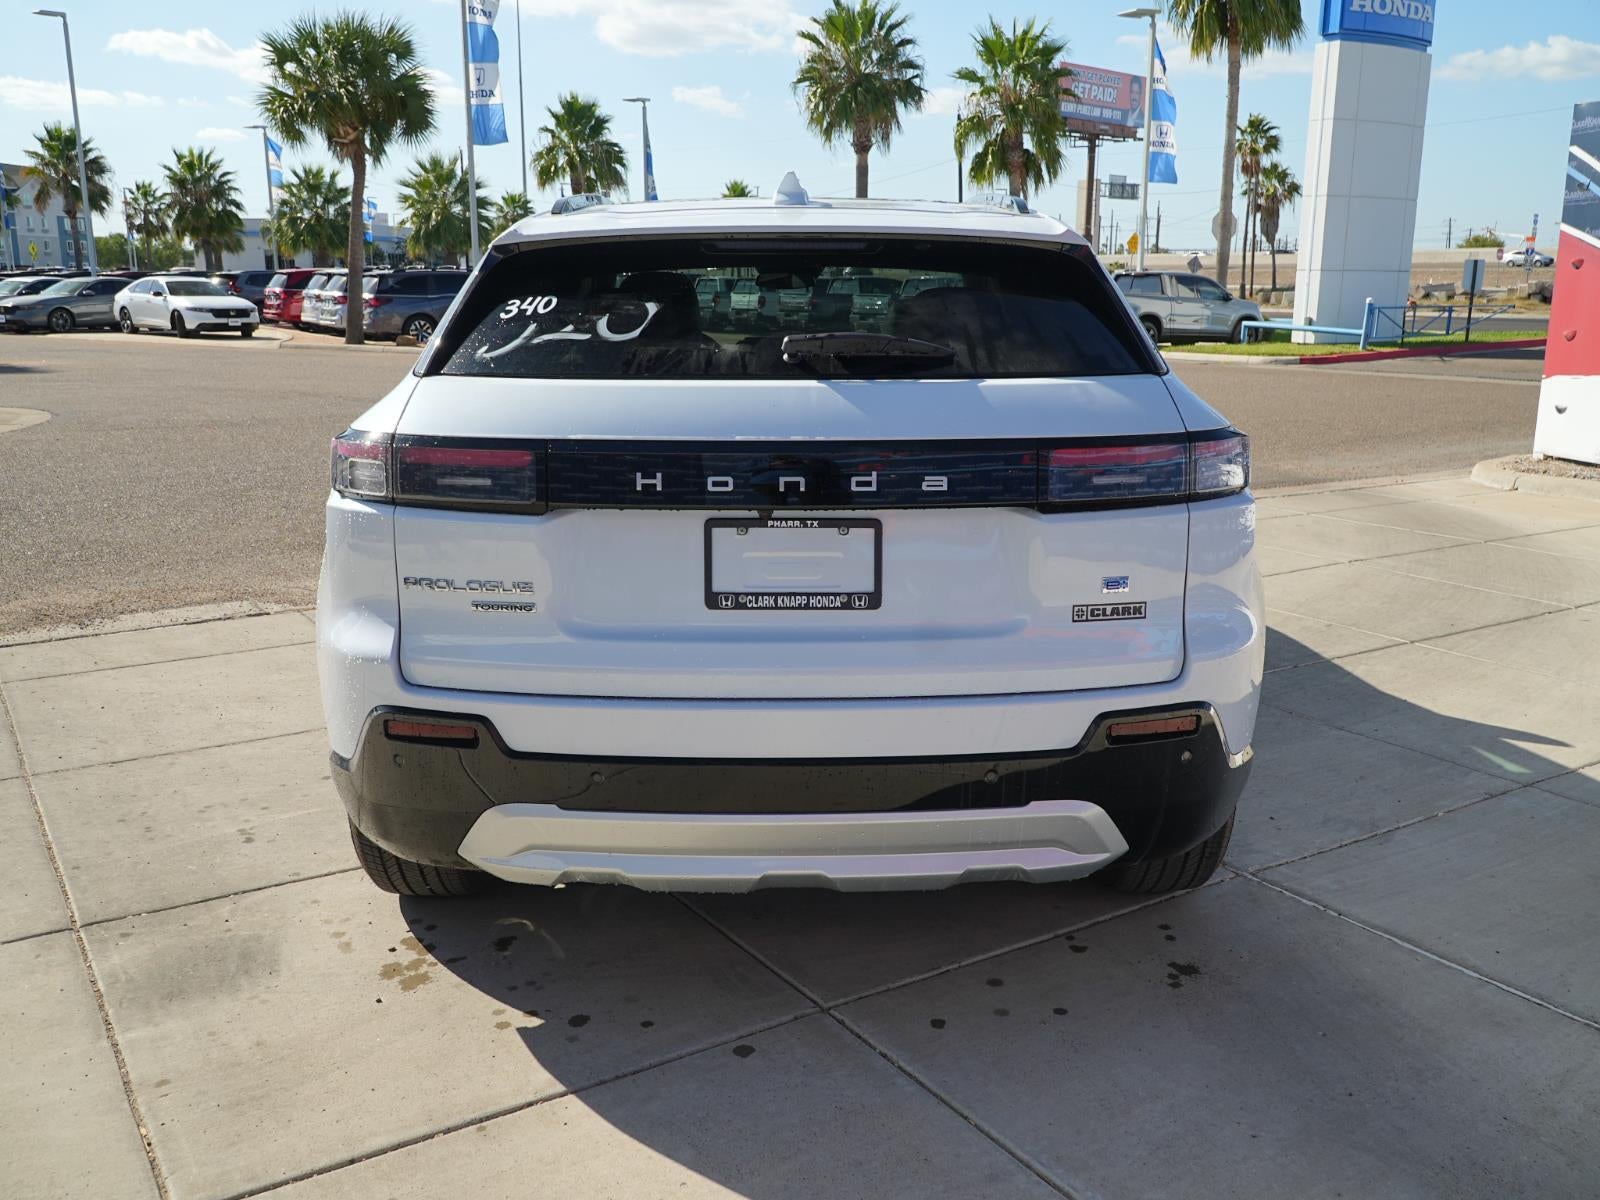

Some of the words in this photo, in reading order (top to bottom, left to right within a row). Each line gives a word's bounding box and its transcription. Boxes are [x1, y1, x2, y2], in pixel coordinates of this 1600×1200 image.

[1350, 0, 1433, 23] HONDA
[1072, 81, 1091, 99] GET
[1092, 86, 1118, 104] PAID!
[500, 295, 558, 319] 340
[806, 520, 819, 528] TX
[403, 576, 534, 595] PROLOGUE
[473, 602, 535, 612] TOURING
[746, 596, 775, 608] CLARK
[778, 596, 807, 608] KNAPP
[809, 596, 841, 608] HONDA
[1089, 605, 1144, 618] CLARK
